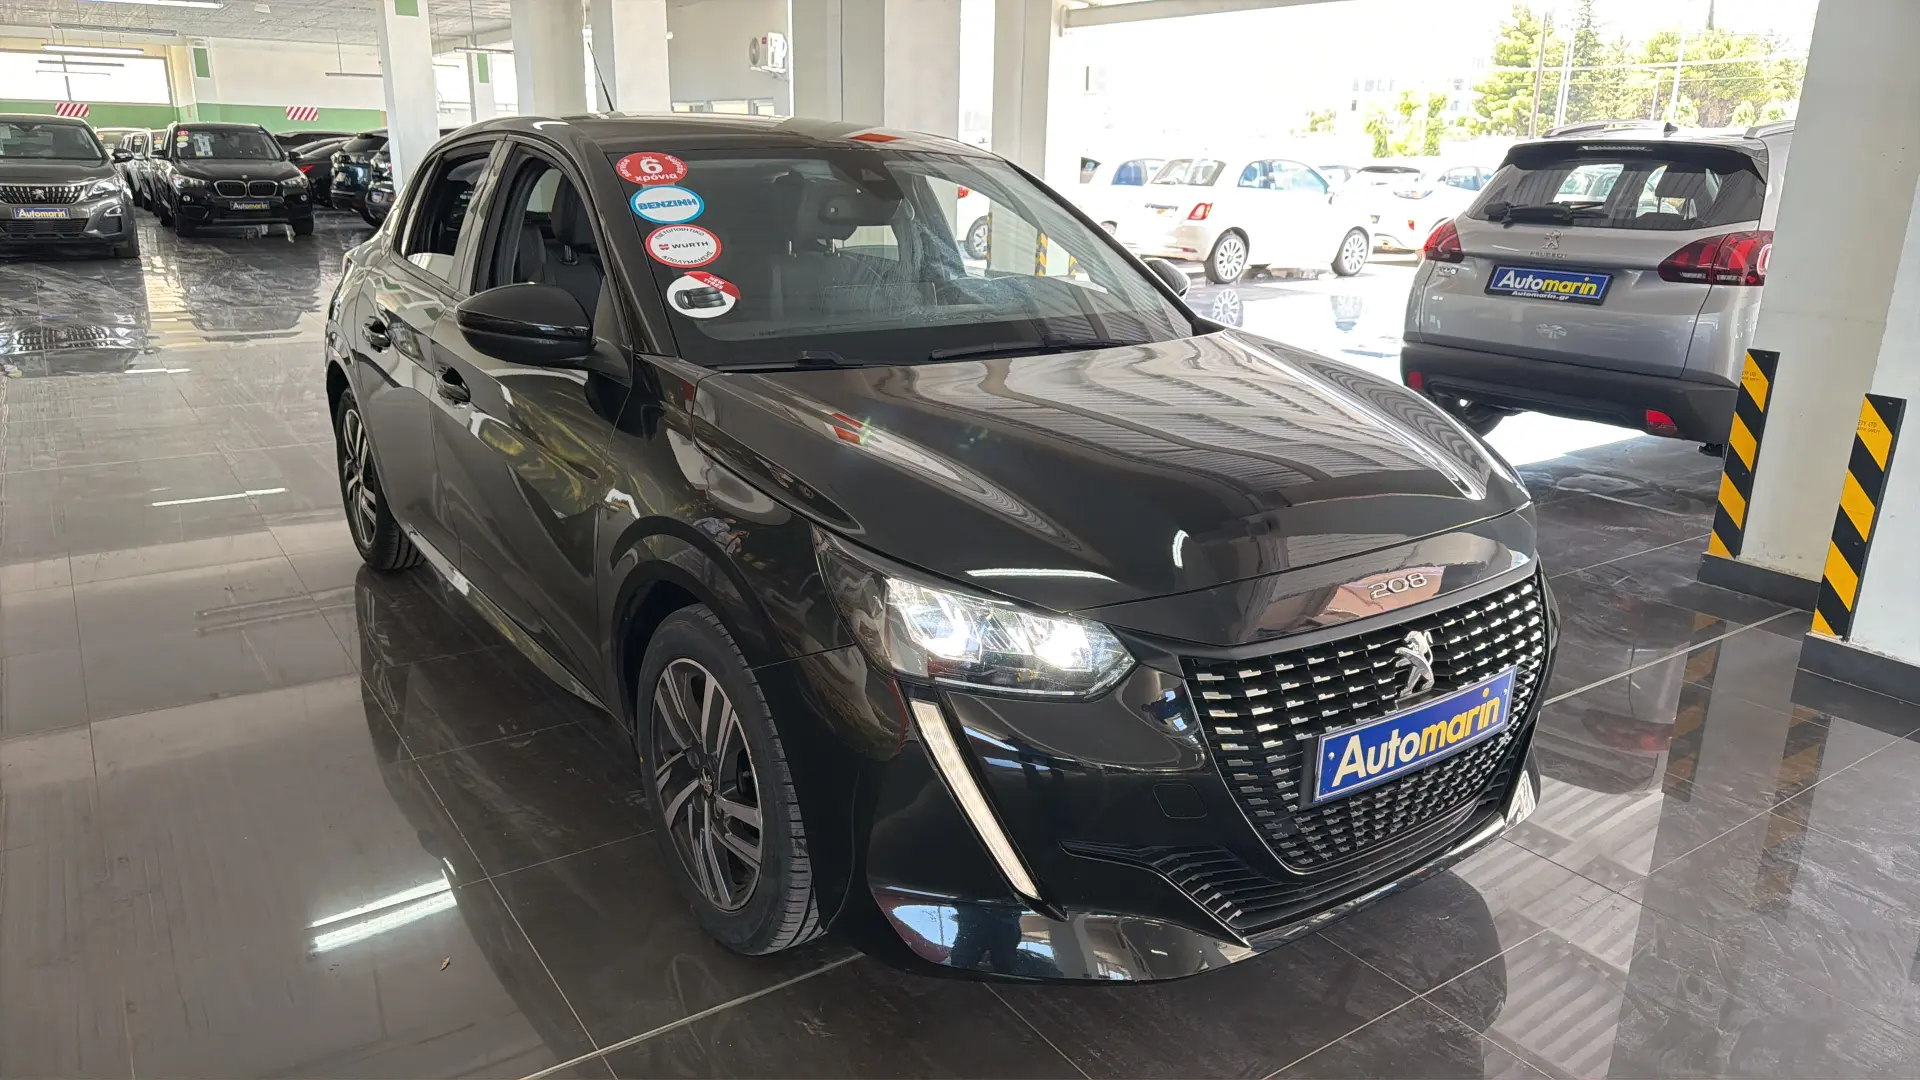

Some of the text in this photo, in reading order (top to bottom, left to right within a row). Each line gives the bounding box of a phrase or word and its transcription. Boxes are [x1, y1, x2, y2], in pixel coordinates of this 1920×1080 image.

[640, 158, 663, 174] 6
[635, 172, 678, 182] χρόνια
[233, 202, 268, 210] Automarin
[638, 198, 698, 210] ΒΕΝΖΙΝΗ
[19, 208, 66, 217] Automarin
[671, 241, 709, 249] WÜRTH
[703, 278, 724, 289] TYRES
[709, 276, 725, 285] NEW
[1498, 270, 1597, 296] Automarin
[1511, 290, 1570, 300] Automarin.gr
[1367, 573, 1427, 599] 208
[1331, 687, 1500, 788] Automarin
